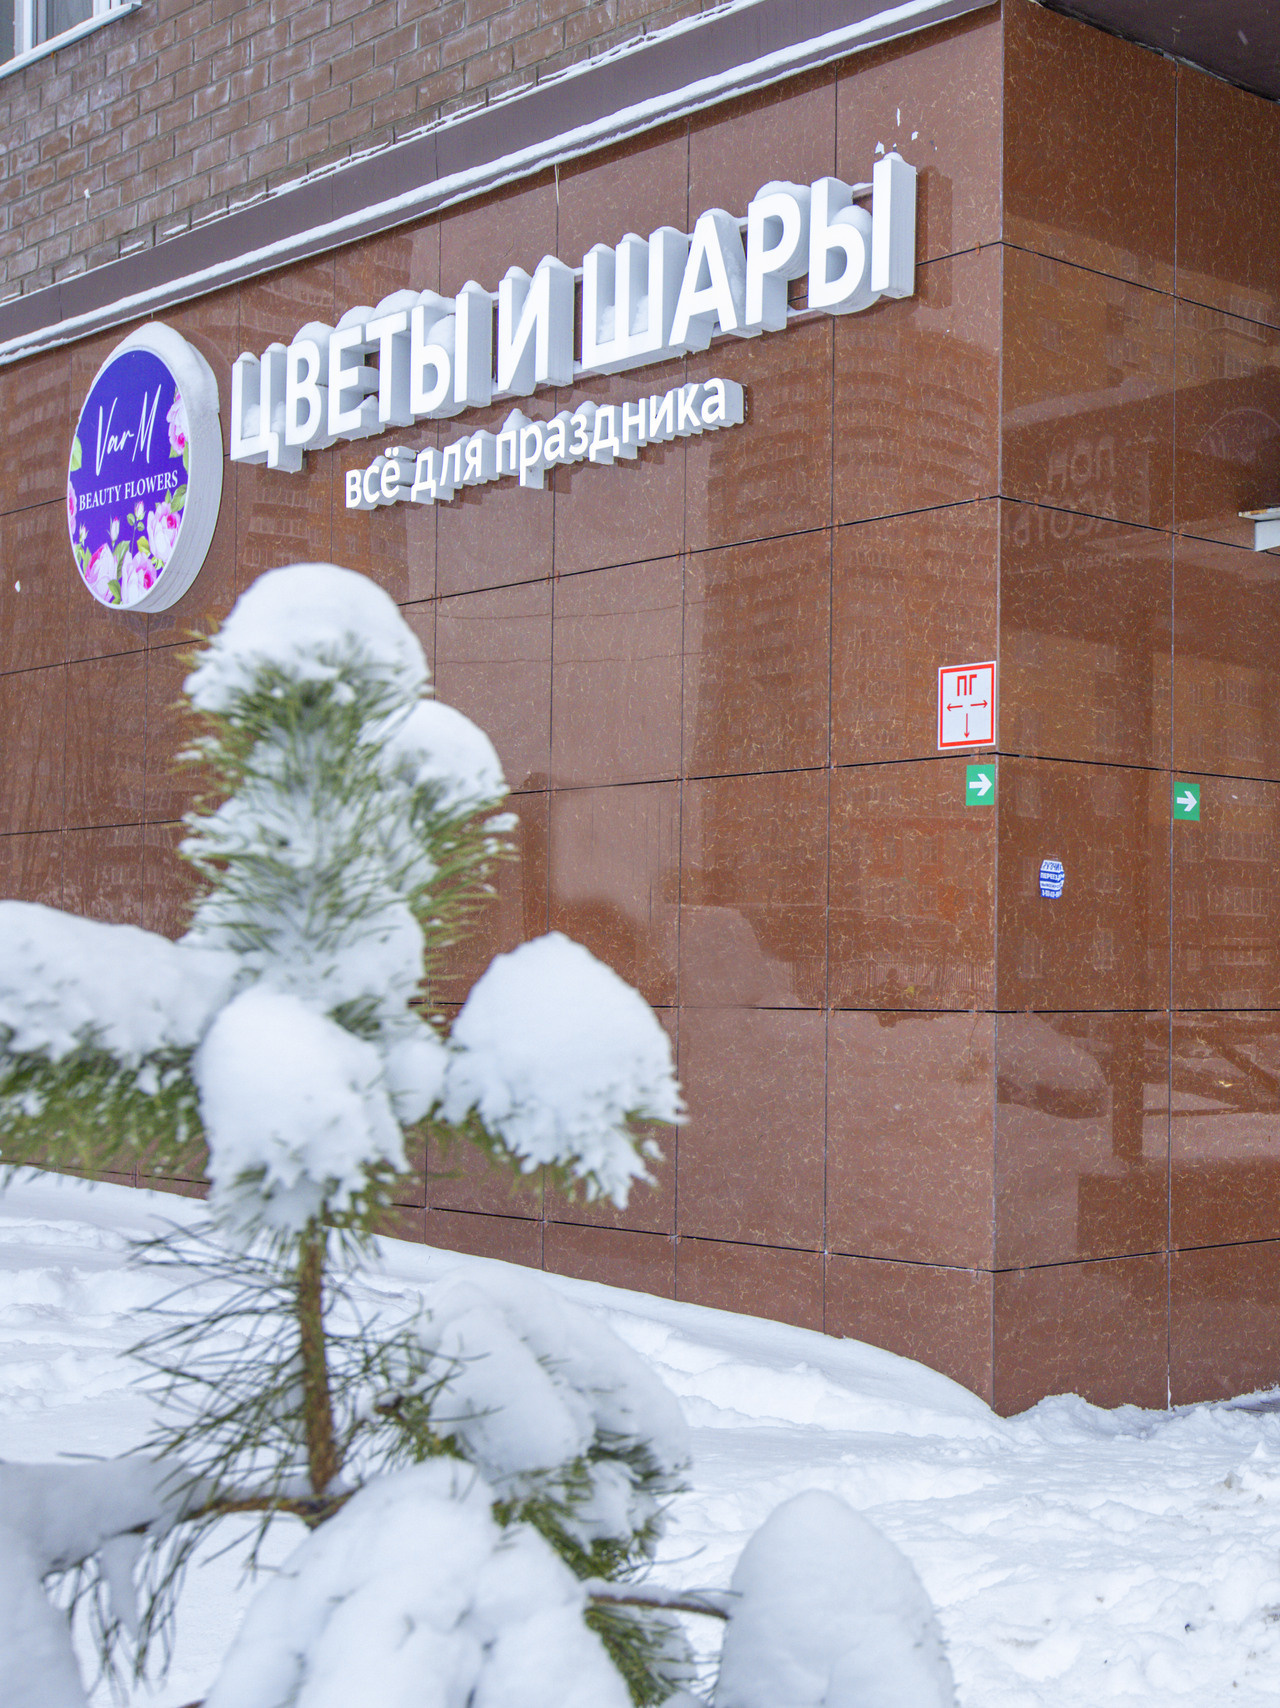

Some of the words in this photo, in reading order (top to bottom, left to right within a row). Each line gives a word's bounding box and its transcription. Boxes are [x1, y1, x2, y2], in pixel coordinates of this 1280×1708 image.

[231, 285, 486, 470] ЦВЕТЫ
[499, 262, 569, 393] И
[582, 156, 912, 373] ШАРЫ
[345, 452, 404, 509] всё
[411, 438, 485, 504] для
[496, 378, 733, 487] праздника
[79, 485, 122, 511] BEAUTY
[124, 470, 178, 500] FLOWERS
[957, 674, 977, 696] ПГ
